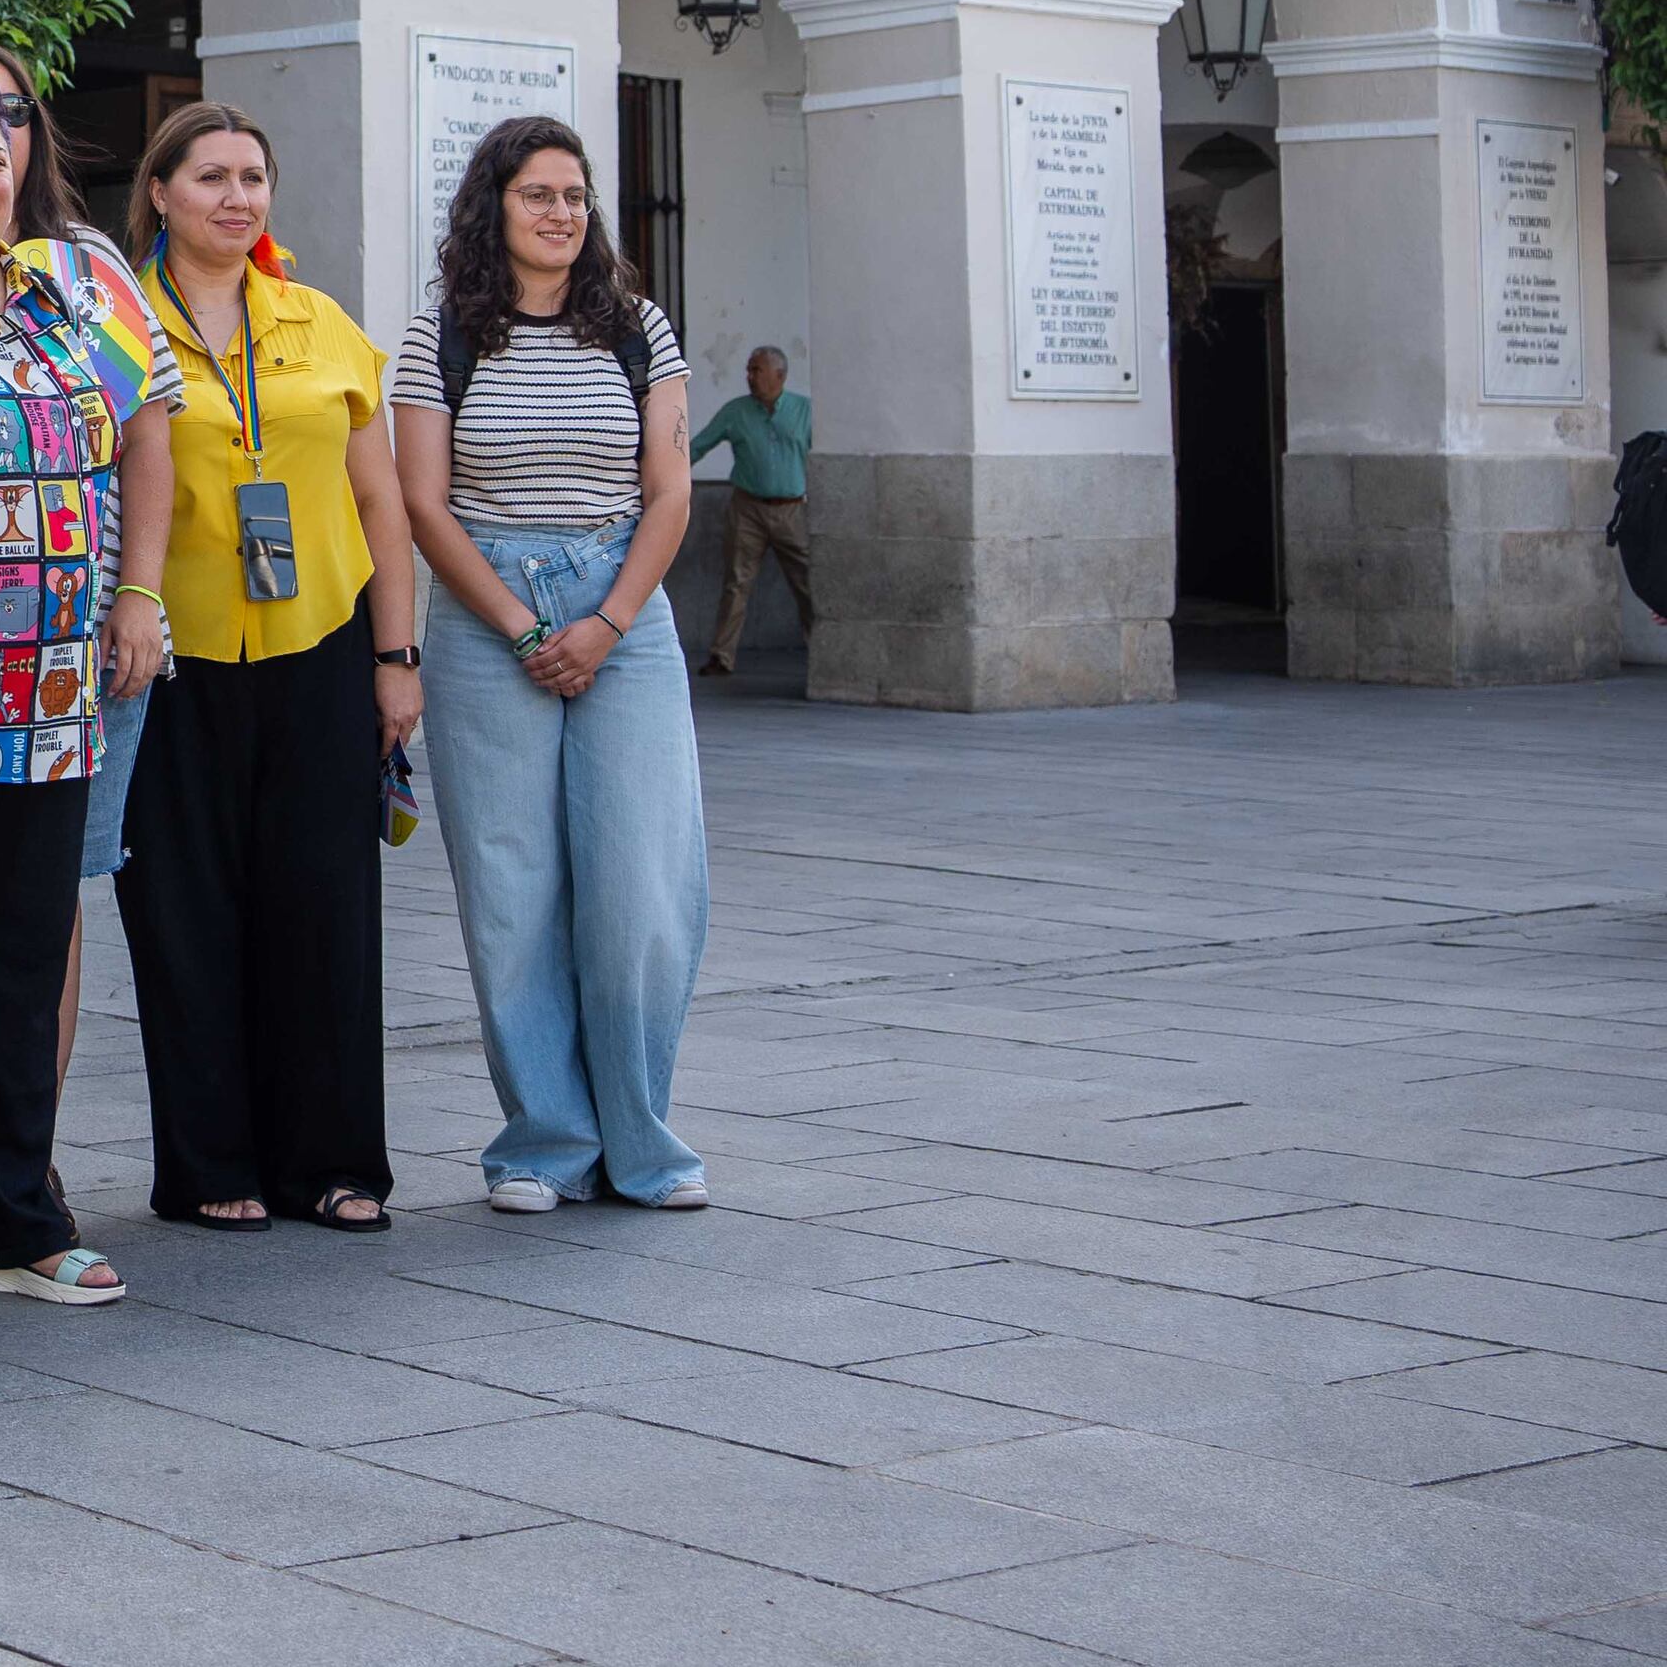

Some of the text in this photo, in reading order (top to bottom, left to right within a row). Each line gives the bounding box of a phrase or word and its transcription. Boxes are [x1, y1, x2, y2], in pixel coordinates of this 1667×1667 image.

[24, 402, 39, 427] MOUSE
[33, 402, 51, 449] NEAPOLITAN
[5, 545, 21, 555] BALL
[22, 545, 35, 555] CAT
[0, 578, 24, 588] JERRY
[52, 646, 73, 656] TRIPLET
[50, 656, 74, 667] TROUBLE
[36, 731, 59, 742] TRIPLET
[13, 732, 25, 754] TOM
[34, 741, 62, 753] TROUBLE
[11, 755, 23, 774] AND
